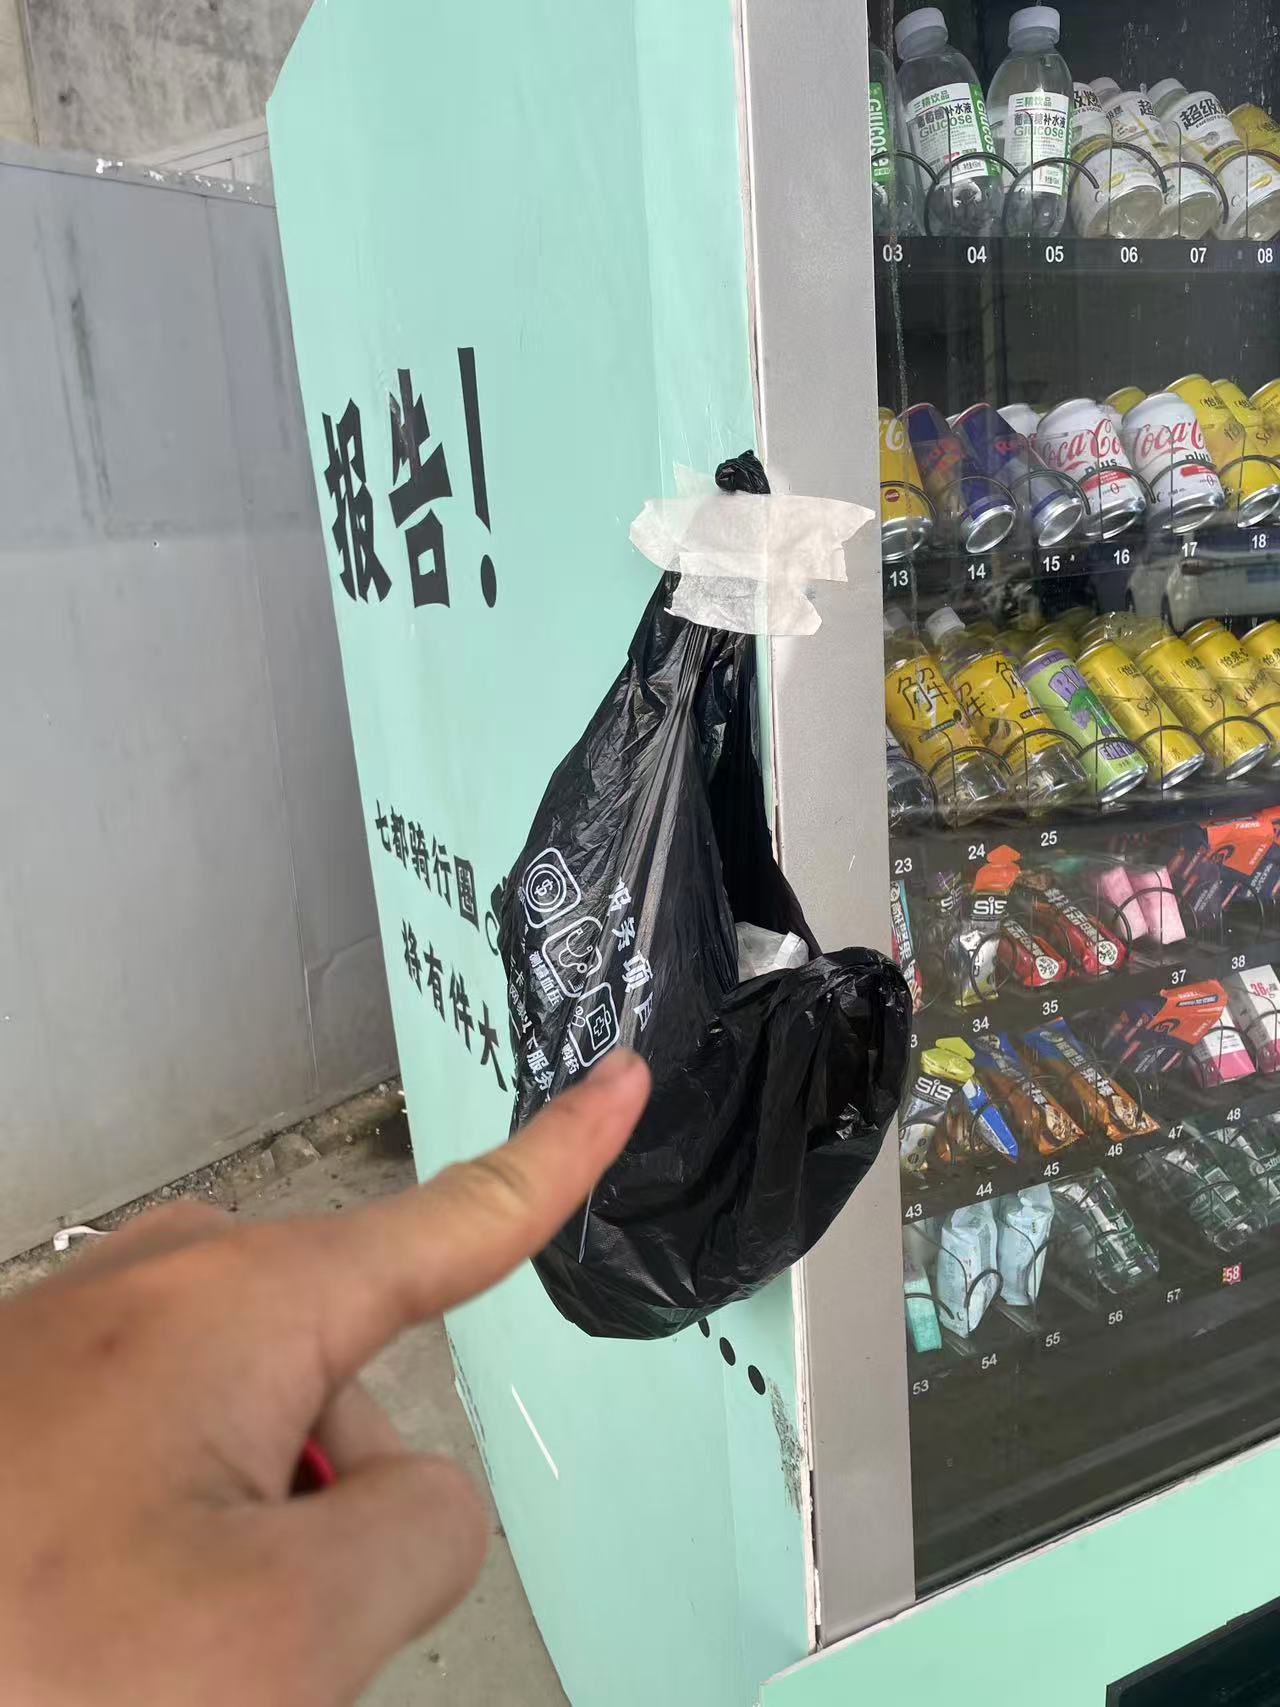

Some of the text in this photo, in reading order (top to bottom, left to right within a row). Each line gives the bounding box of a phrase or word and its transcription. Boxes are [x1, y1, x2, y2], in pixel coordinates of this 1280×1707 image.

[919, 114, 973, 138] Glucose
[1014, 127, 1064, 138] Glucose
[883, 244, 903, 262] 03
[967, 246, 987, 264] 04
[1046, 245, 1064, 263] 05
[1121, 245, 1138, 263] 06
[1190, 246, 1207, 264] 07
[1257, 248, 1273, 263] 08
[1181, 542, 1198, 558] 17
[1252, 534, 1267, 549] 18
[1043, 554, 1060, 572] 15
[1113, 548, 1130, 565] 16
[889, 570, 909, 587] 13
[968, 563, 986, 581] 14
[1041, 831, 1057, 847] 25
[968, 844, 986, 860] 24
[895, 857, 913, 875] 23
[1231, 955, 1246, 970] 38
[529, 951, 564, 1010] 测量血压
[1171, 968, 1187, 984] 37
[1042, 999, 1058, 1016] 35
[972, 1015, 989, 1032] 34
[1226, 1106, 1241, 1122] 48
[1167, 1123, 1184, 1140] 47
[1107, 1142, 1123, 1158] 46
[1043, 1161, 1060, 1177] 45
[976, 1182, 993, 1198] 44
[905, 1202, 922, 1219] 43
[1226, 1265, 1240, 1282] 58
[1166, 1287, 1181, 1303] 57
[1108, 1309, 1123, 1326] 56
[1045, 1330, 1060, 1347] 55
[981, 1352, 997, 1369] 54
[913, 1378, 929, 1395] 53
